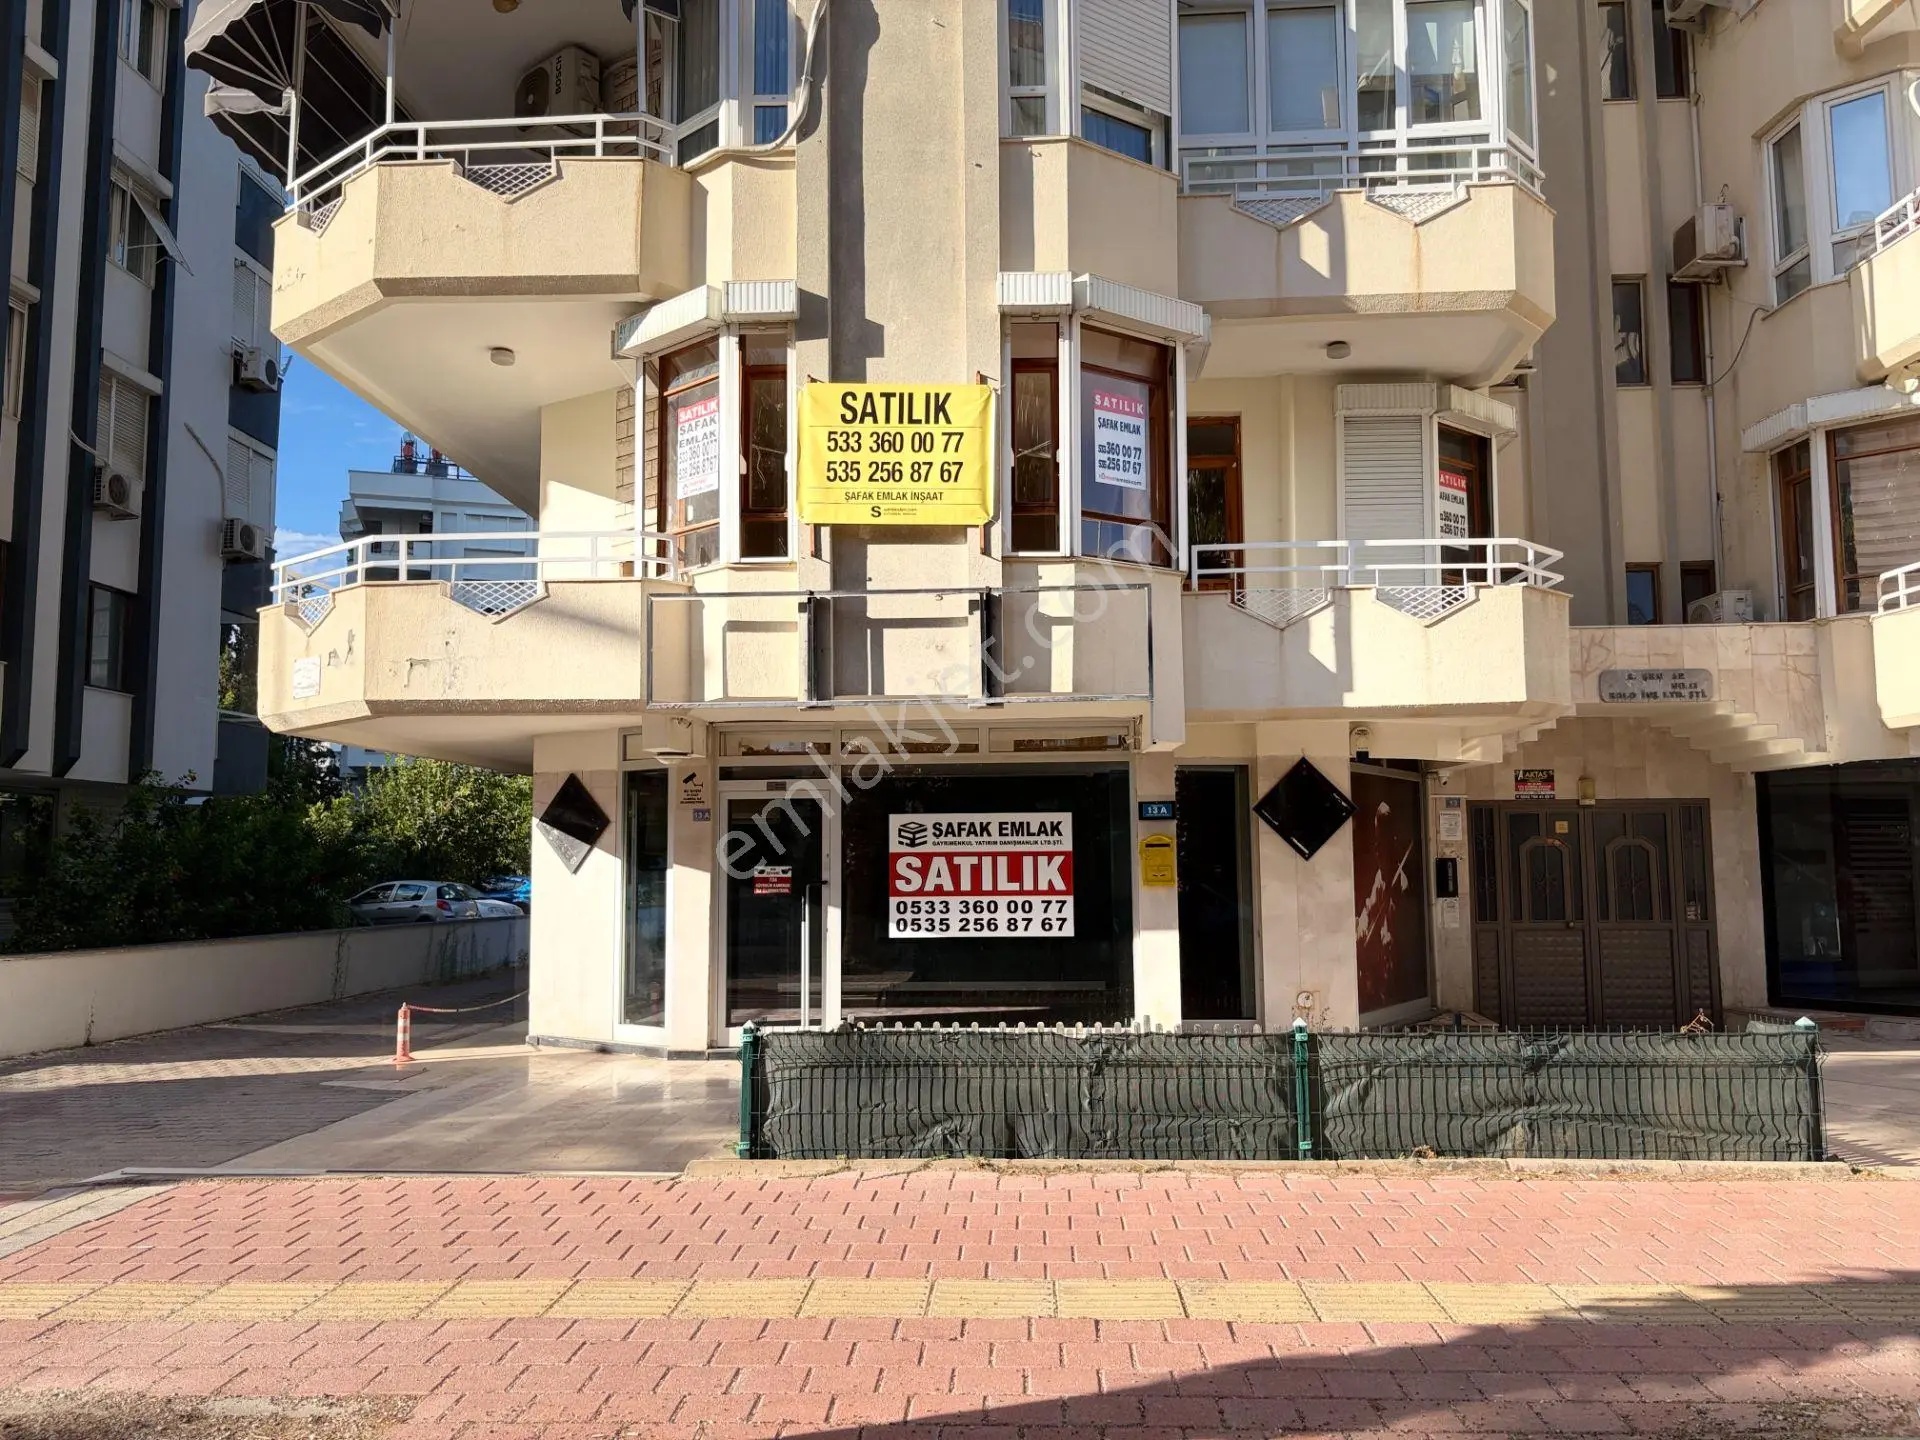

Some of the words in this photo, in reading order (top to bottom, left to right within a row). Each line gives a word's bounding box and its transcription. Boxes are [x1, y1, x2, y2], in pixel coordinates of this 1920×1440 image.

[679, 400, 718, 421] SATILIK
[841, 391, 952, 424] SATILIK
[1094, 394, 1144, 415] SATILIK
[1120, 420, 1141, 435] EMLAK
[680, 430, 717, 449] EMLAK
[827, 431, 862, 453] 533
[869, 431, 904, 453] 360
[911, 431, 934, 453] 00
[941, 431, 964, 453] 77
[1121, 445, 1132, 459] 00
[1133, 447, 1142, 461] 77
[826, 460, 861, 483] 535
[868, 461, 903, 483] 256
[910, 461, 933, 483] 87
[940, 461, 964, 483] 67
[1122, 460, 1131, 473] 87
[1132, 462, 1142, 476] 67
[1440, 473, 1467, 489] ATILIK
[844, 491, 874, 504] ŞAFAK
[876, 491, 908, 501] EMLAK
[910, 490, 944, 504] İNŞAAT
[1147, 806, 1158, 814] 13
[1160, 806, 1168, 815] A
[932, 821, 992, 839] ŞAFAK
[998, 821, 1063, 837] EMLAK
[895, 855, 1067, 892] SATILIK
[896, 900, 950, 915] 0533
[958, 900, 998, 914] 360
[1006, 900, 1033, 914] 00
[1041, 900, 1067, 914] 77
[896, 918, 950, 933] 0535
[958, 918, 998, 932] 256
[1006, 918, 1033, 932] 87
[1041, 917, 1067, 932] 67
